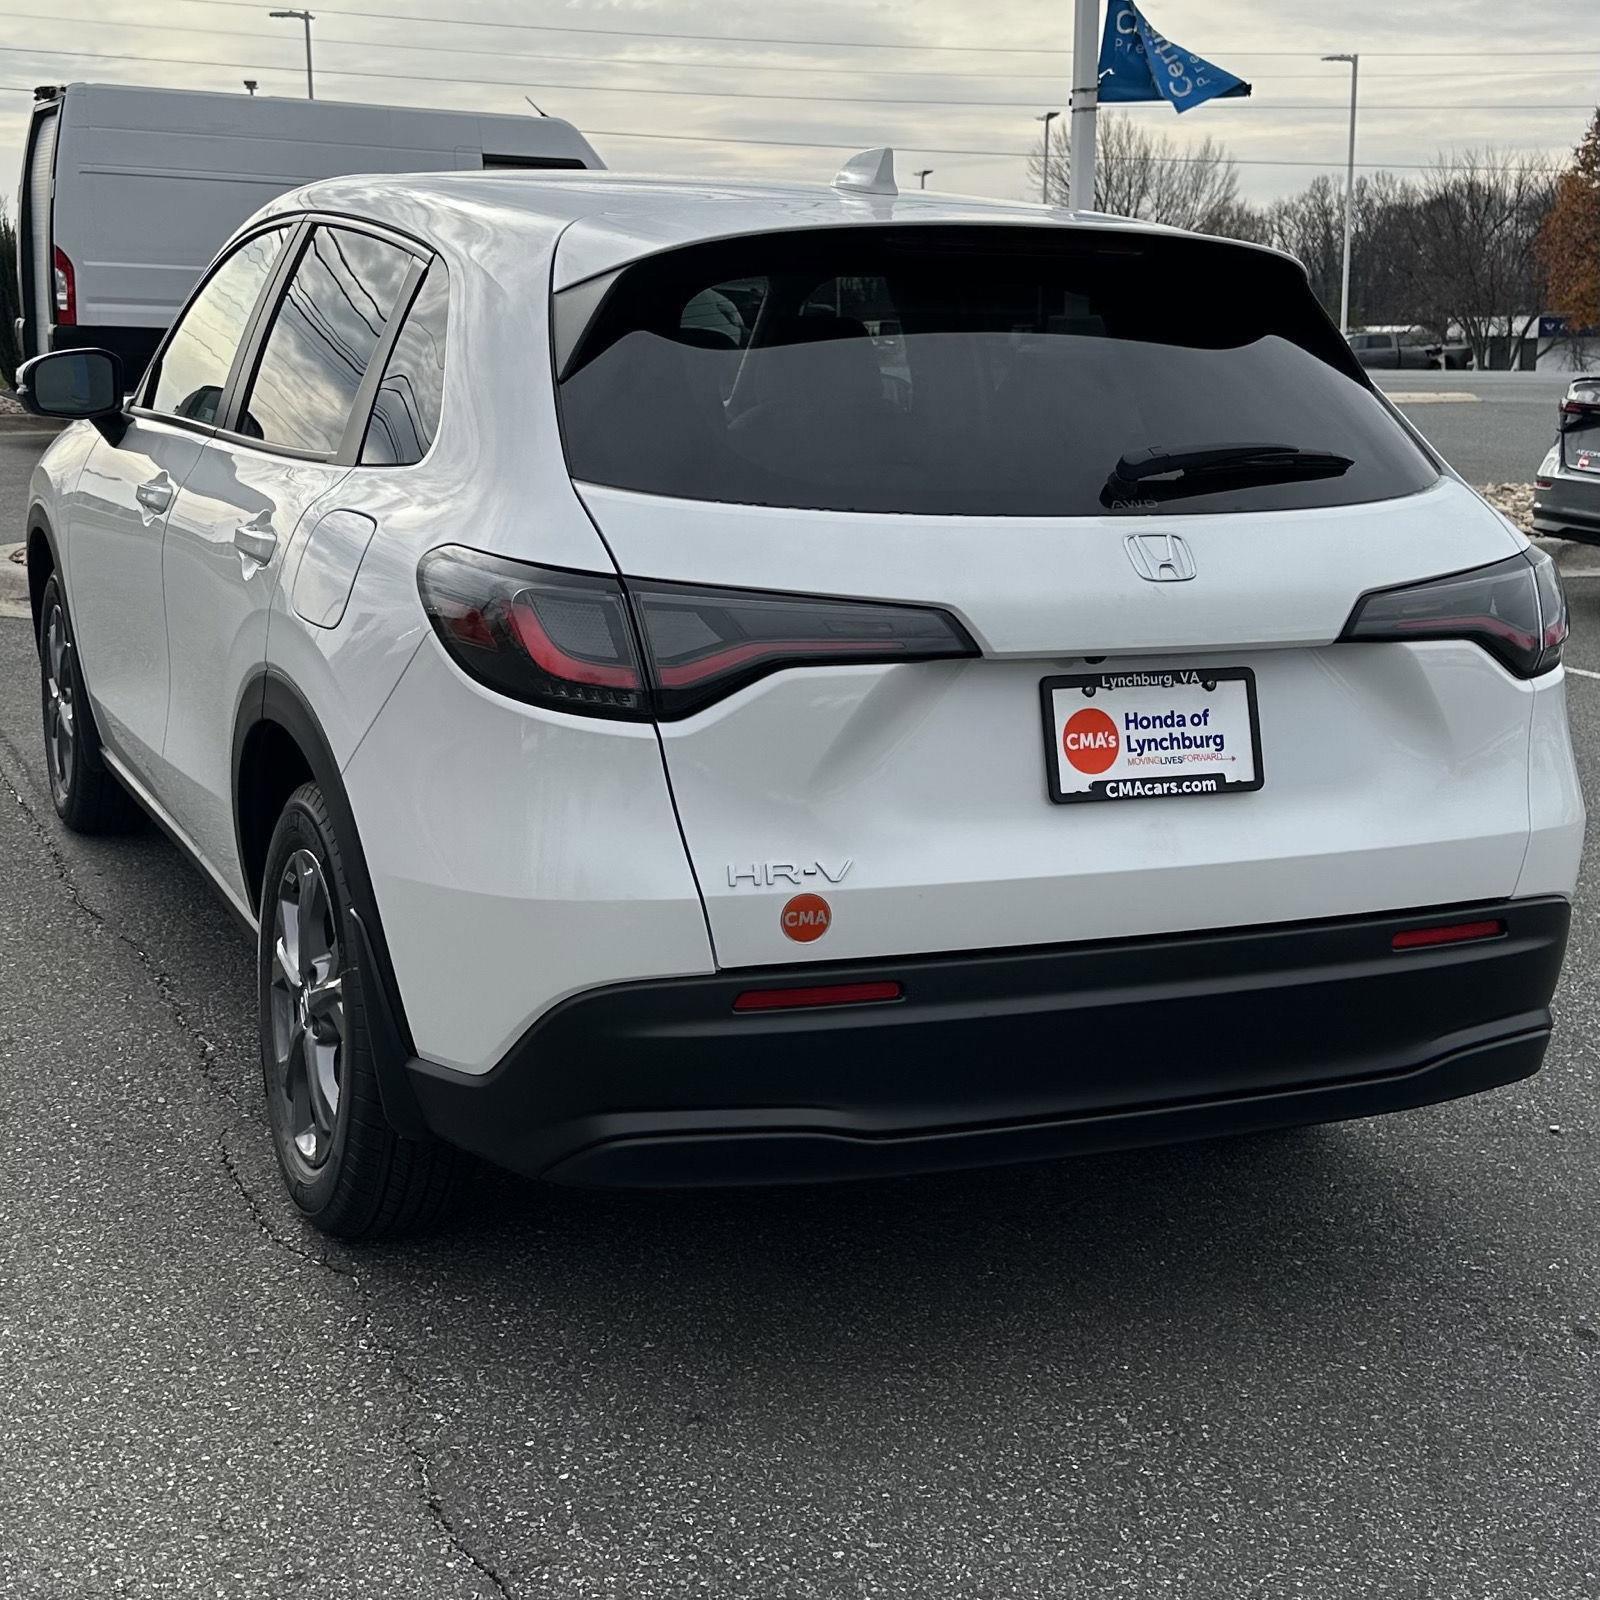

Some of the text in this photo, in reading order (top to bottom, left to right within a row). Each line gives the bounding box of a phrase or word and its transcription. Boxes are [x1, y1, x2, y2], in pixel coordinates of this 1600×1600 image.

[1111, 499, 1159, 509] AWD
[1180, 671, 1201, 683] VA
[1124, 708, 1210, 731] Honda of
[1065, 731, 1117, 751] CMA's
[1126, 732, 1225, 757] Lynchburg
[1105, 778, 1217, 798] CMAcars.com
[727, 859, 854, 888] HR-V
[784, 909, 828, 928] CMA
